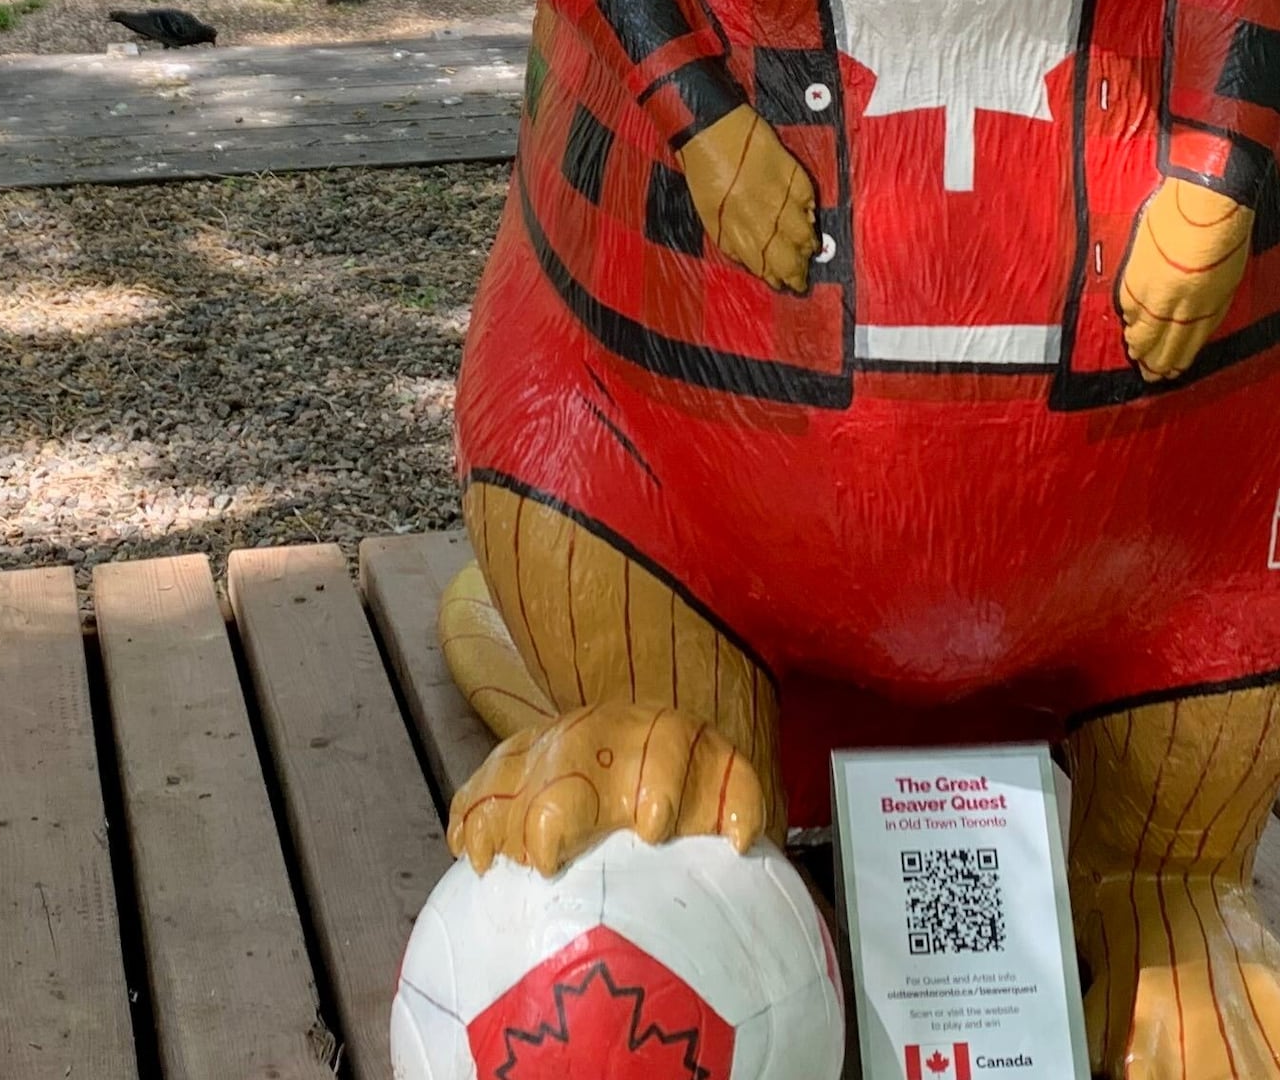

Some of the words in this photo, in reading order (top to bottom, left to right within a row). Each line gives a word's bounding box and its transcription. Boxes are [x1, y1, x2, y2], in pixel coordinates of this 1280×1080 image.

[895, 777, 931, 793] The
[935, 775, 988, 792] Great
[881, 797, 947, 813] Beaver
[951, 794, 1007, 811] Quest
[899, 817, 921, 830] Old
[925, 817, 957, 830] Town
[960, 815, 1007, 829] Toronto
[906, 976, 920, 986] For
[923, 975, 950, 986] Quest
[953, 974, 970, 985] and
[973, 972, 995, 983] Artist
[910, 1009, 932, 1019] Scan
[935, 1009, 944, 1018] or
[947, 1006, 964, 1017] visit
[967, 1006, 981, 1016] the
[985, 1004, 1020, 1016] website
[931, 1021, 941, 1031] to
[943, 1021, 962, 1032] play
[965, 1020, 982, 1029] and
[976, 1054, 1034, 1069] Canada
